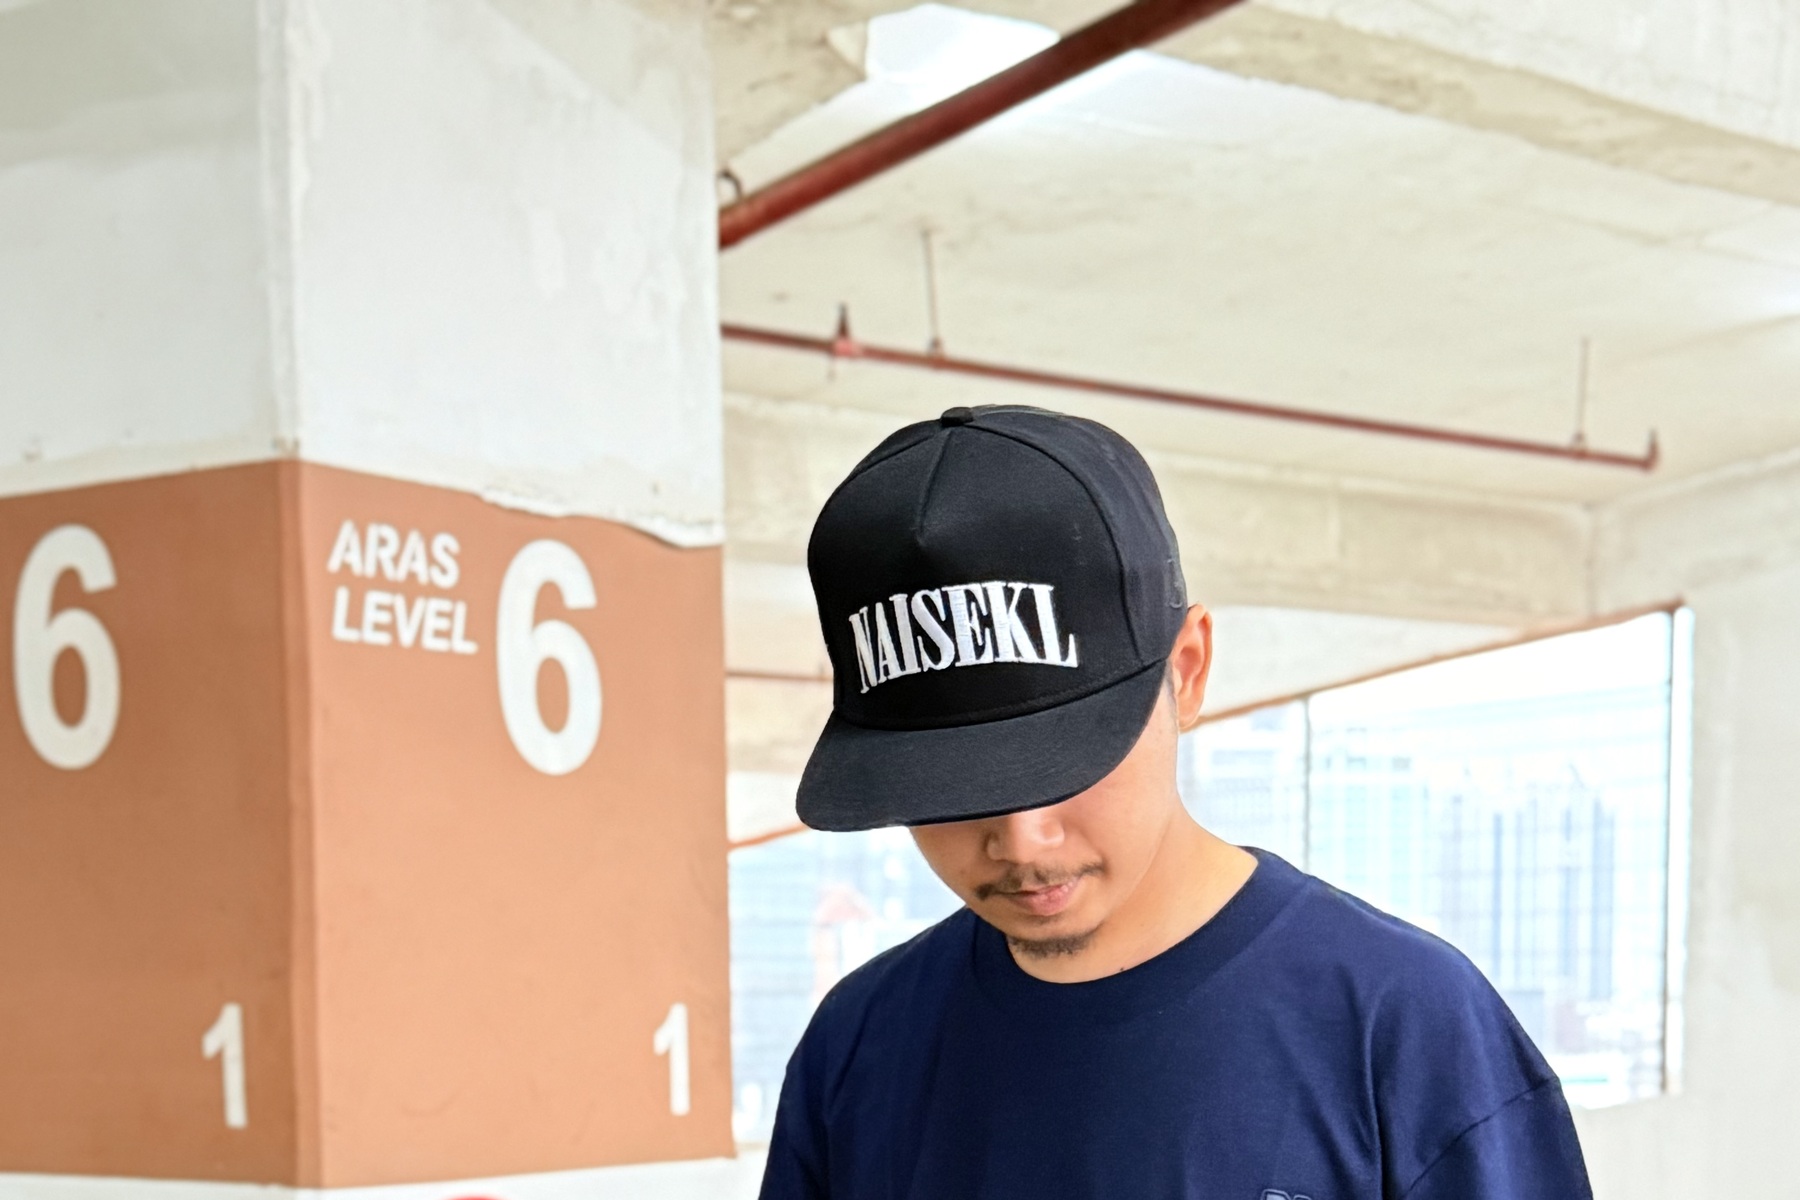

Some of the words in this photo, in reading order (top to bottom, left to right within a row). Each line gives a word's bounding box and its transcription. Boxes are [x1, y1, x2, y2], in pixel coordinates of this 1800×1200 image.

[328, 520, 460, 588] ARAS
[13, 524, 120, 769] 6
[332, 587, 478, 654] LEVEL
[496, 539, 602, 775] 6
[849, 580, 1079, 693] NAISEKL
[203, 1002, 247, 1128] 1
[653, 1003, 691, 1116] 1
